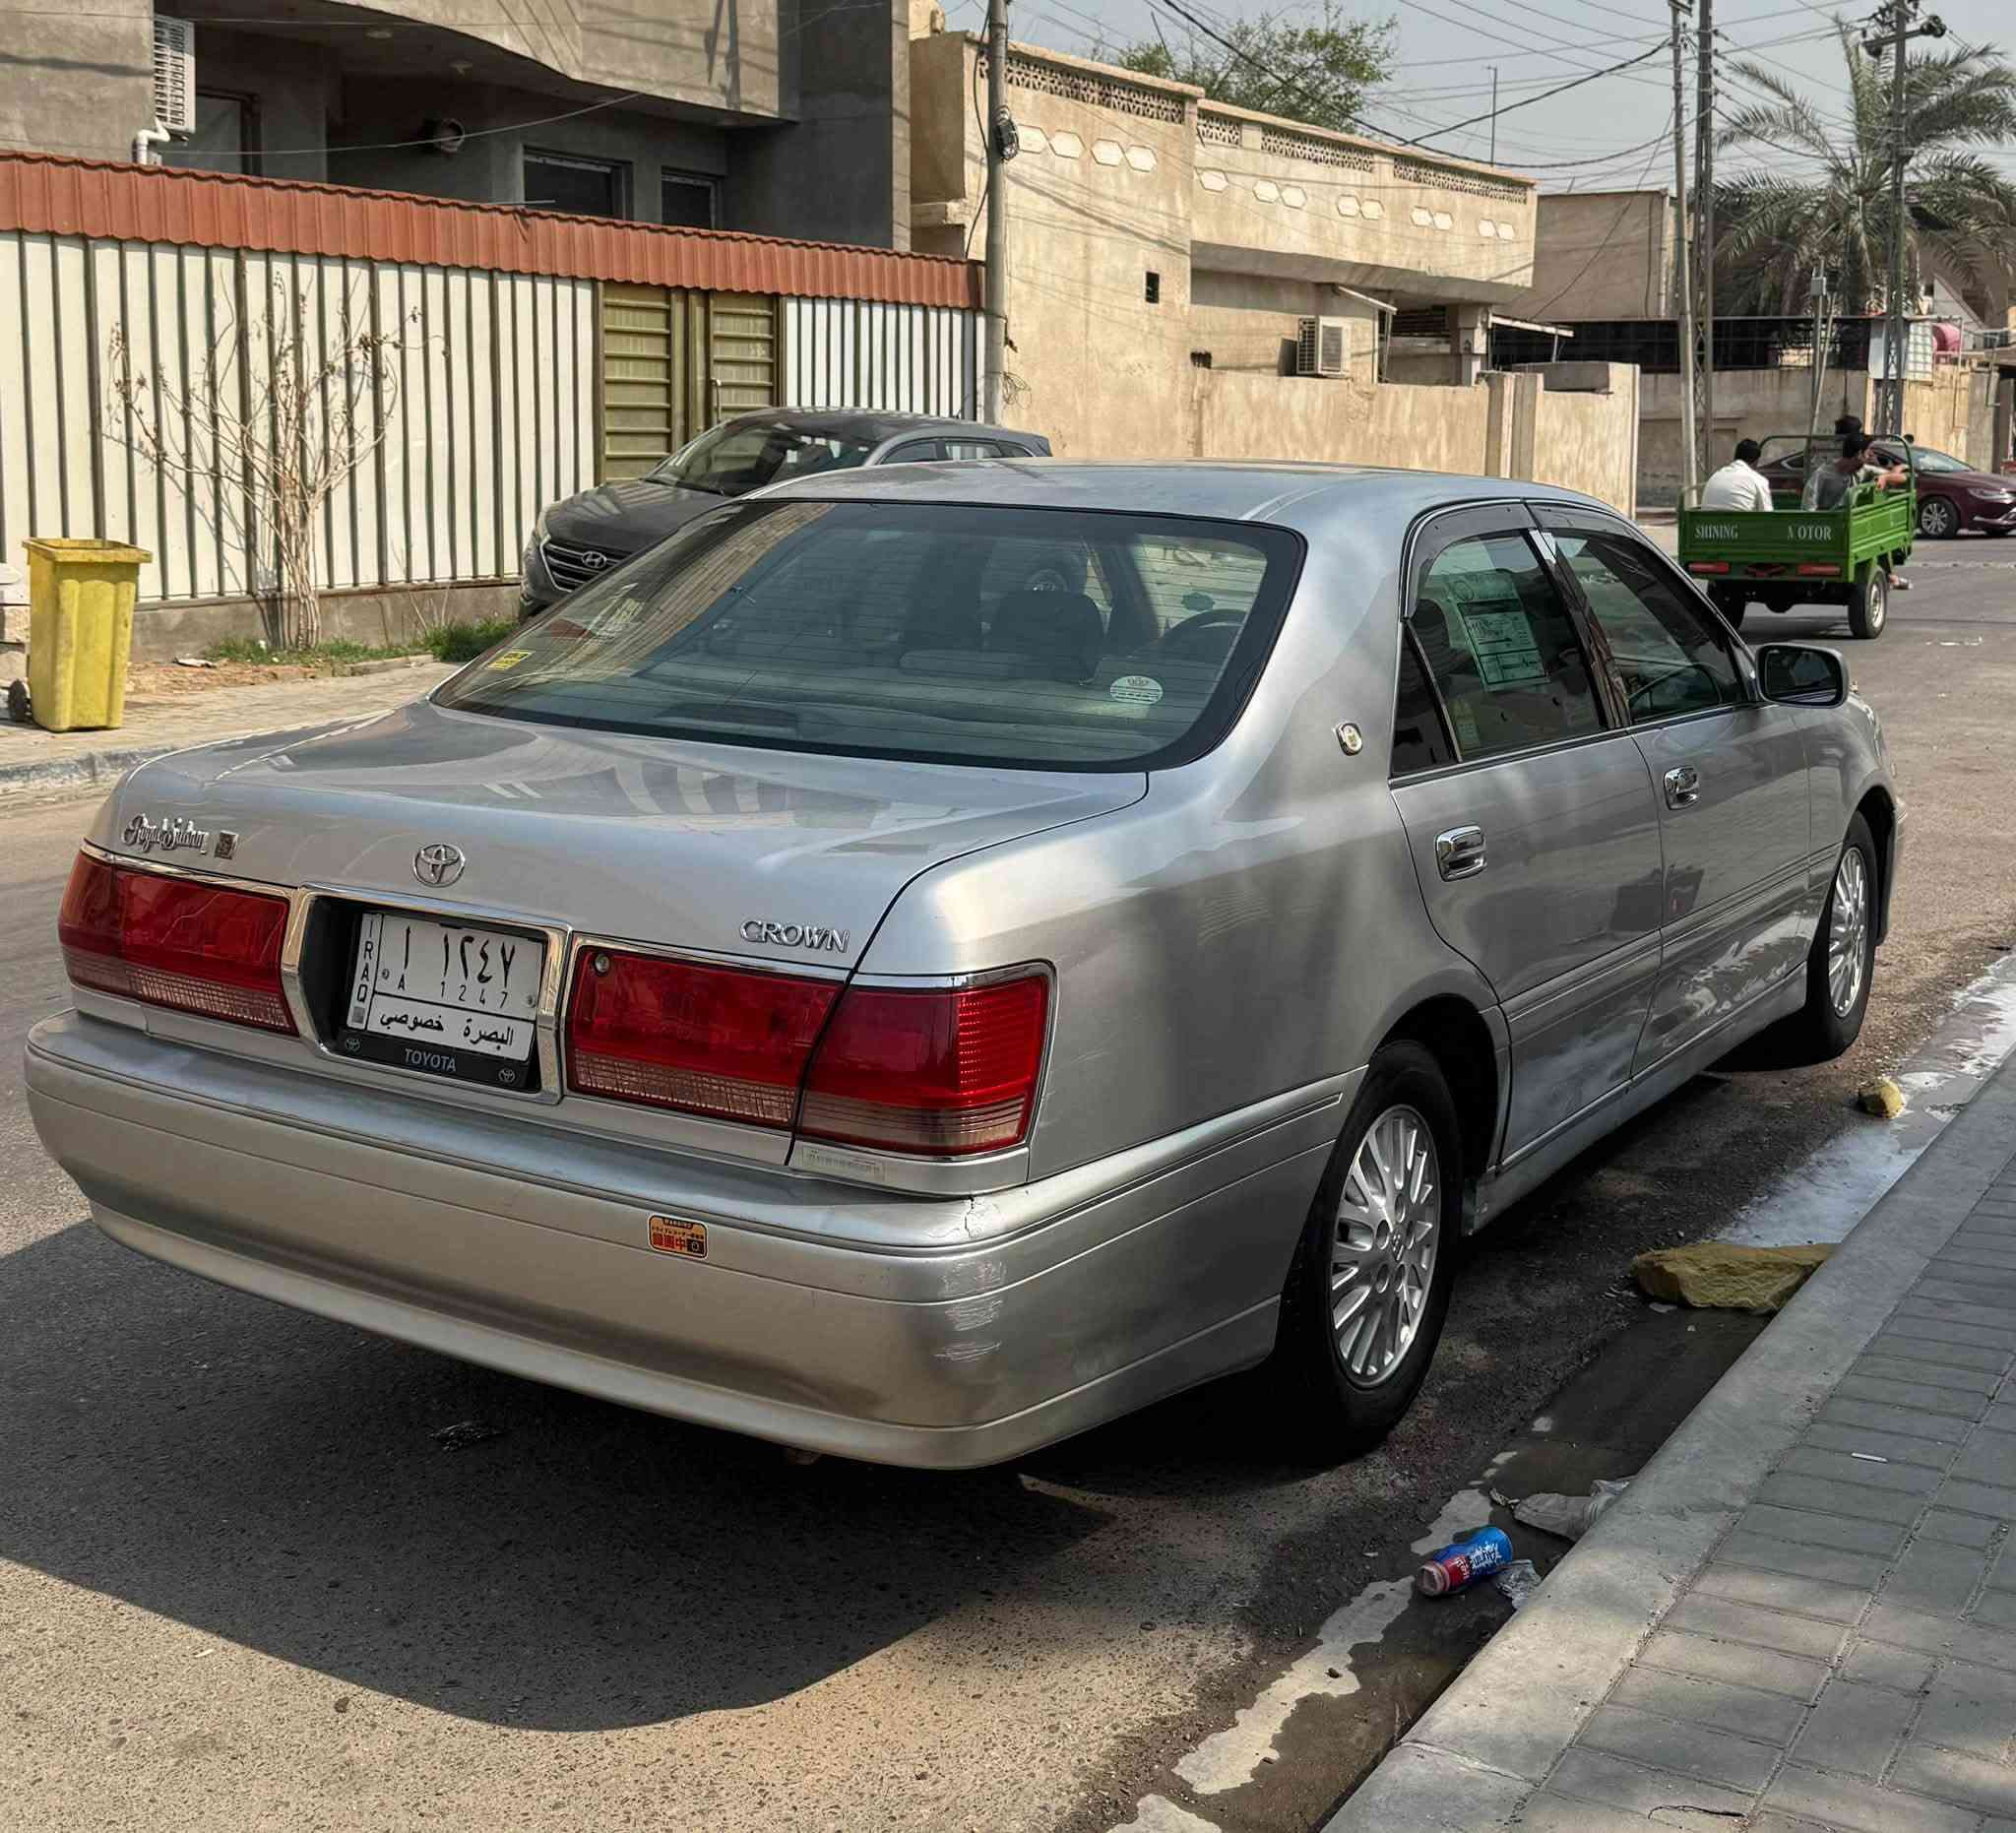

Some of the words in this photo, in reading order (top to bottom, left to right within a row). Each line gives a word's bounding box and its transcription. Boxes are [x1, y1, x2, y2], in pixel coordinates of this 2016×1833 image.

[1694, 524, 1738, 540] SHINING
[739, 919, 850, 954] CROWN
[356, 919, 374, 1003] IRAQ
[398, 974, 406, 991] A
[379, 1013, 445, 1031] خصوصي
[463, 1017, 514, 1050] البصرة
[405, 1047, 457, 1072] TOYOTA
